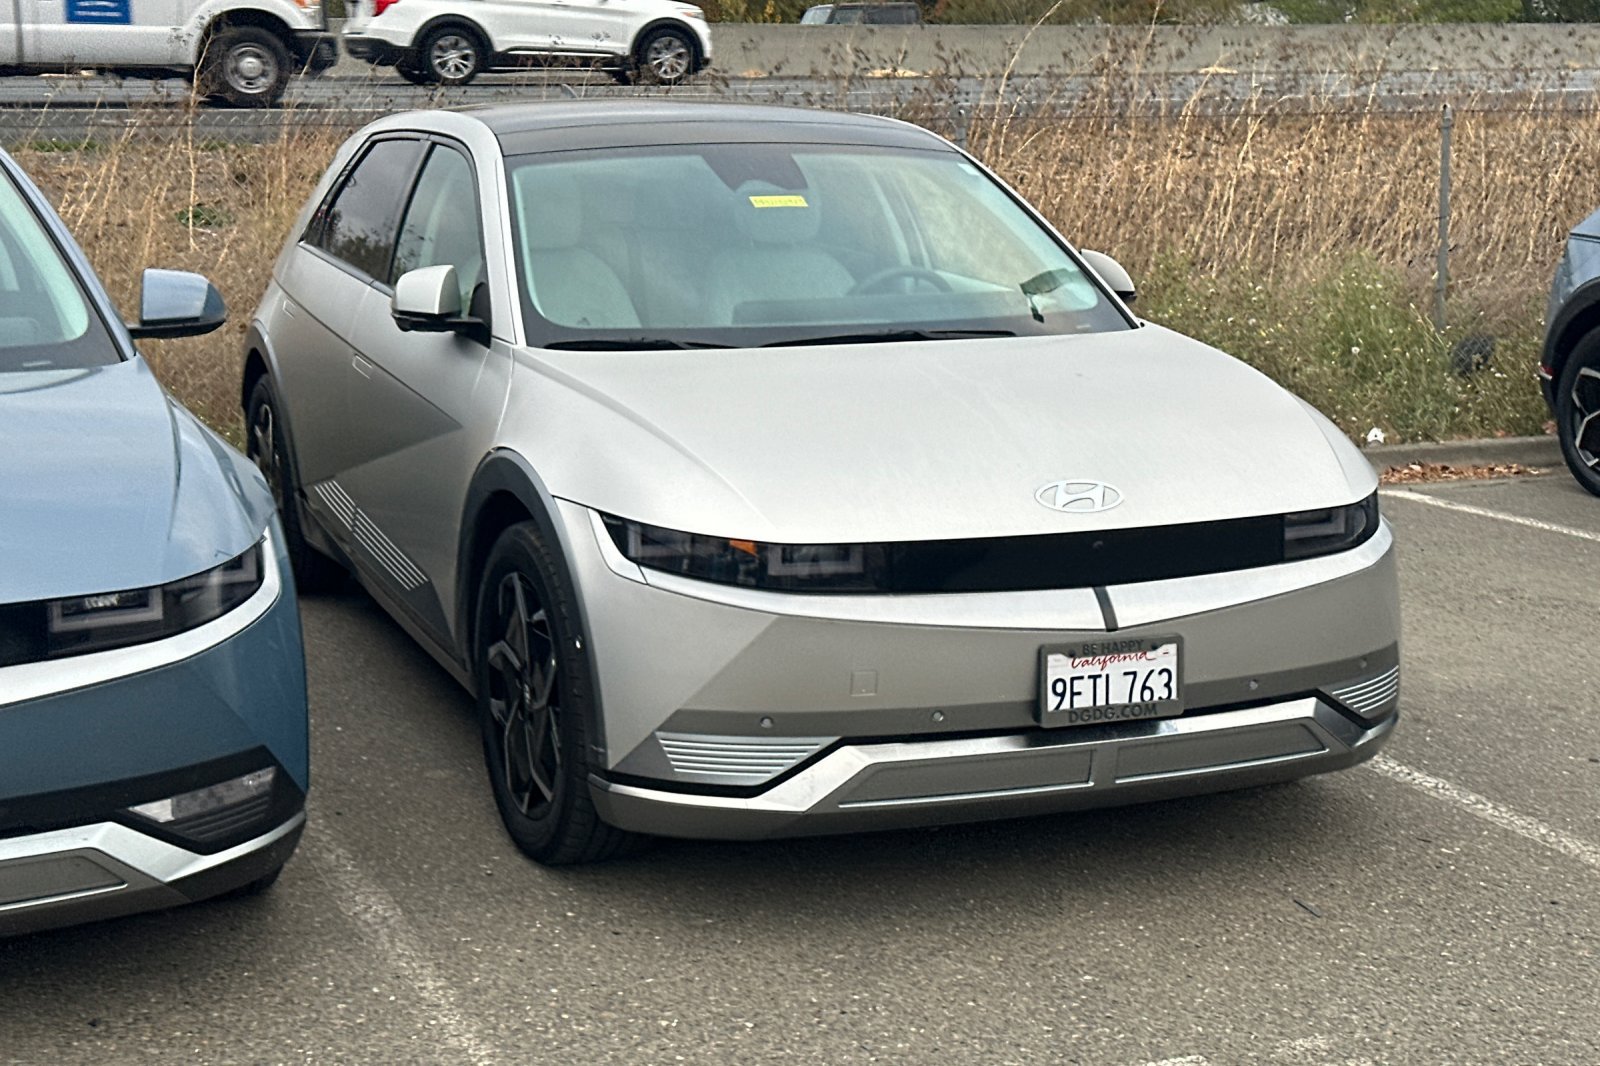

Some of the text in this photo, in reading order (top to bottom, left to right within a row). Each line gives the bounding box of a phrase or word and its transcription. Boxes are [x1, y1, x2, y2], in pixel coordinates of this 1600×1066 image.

[1101, 639, 1144, 653] HAPPY
[1071, 650, 1157, 671] California
[1068, 703, 1158, 724] DGDG.COM
